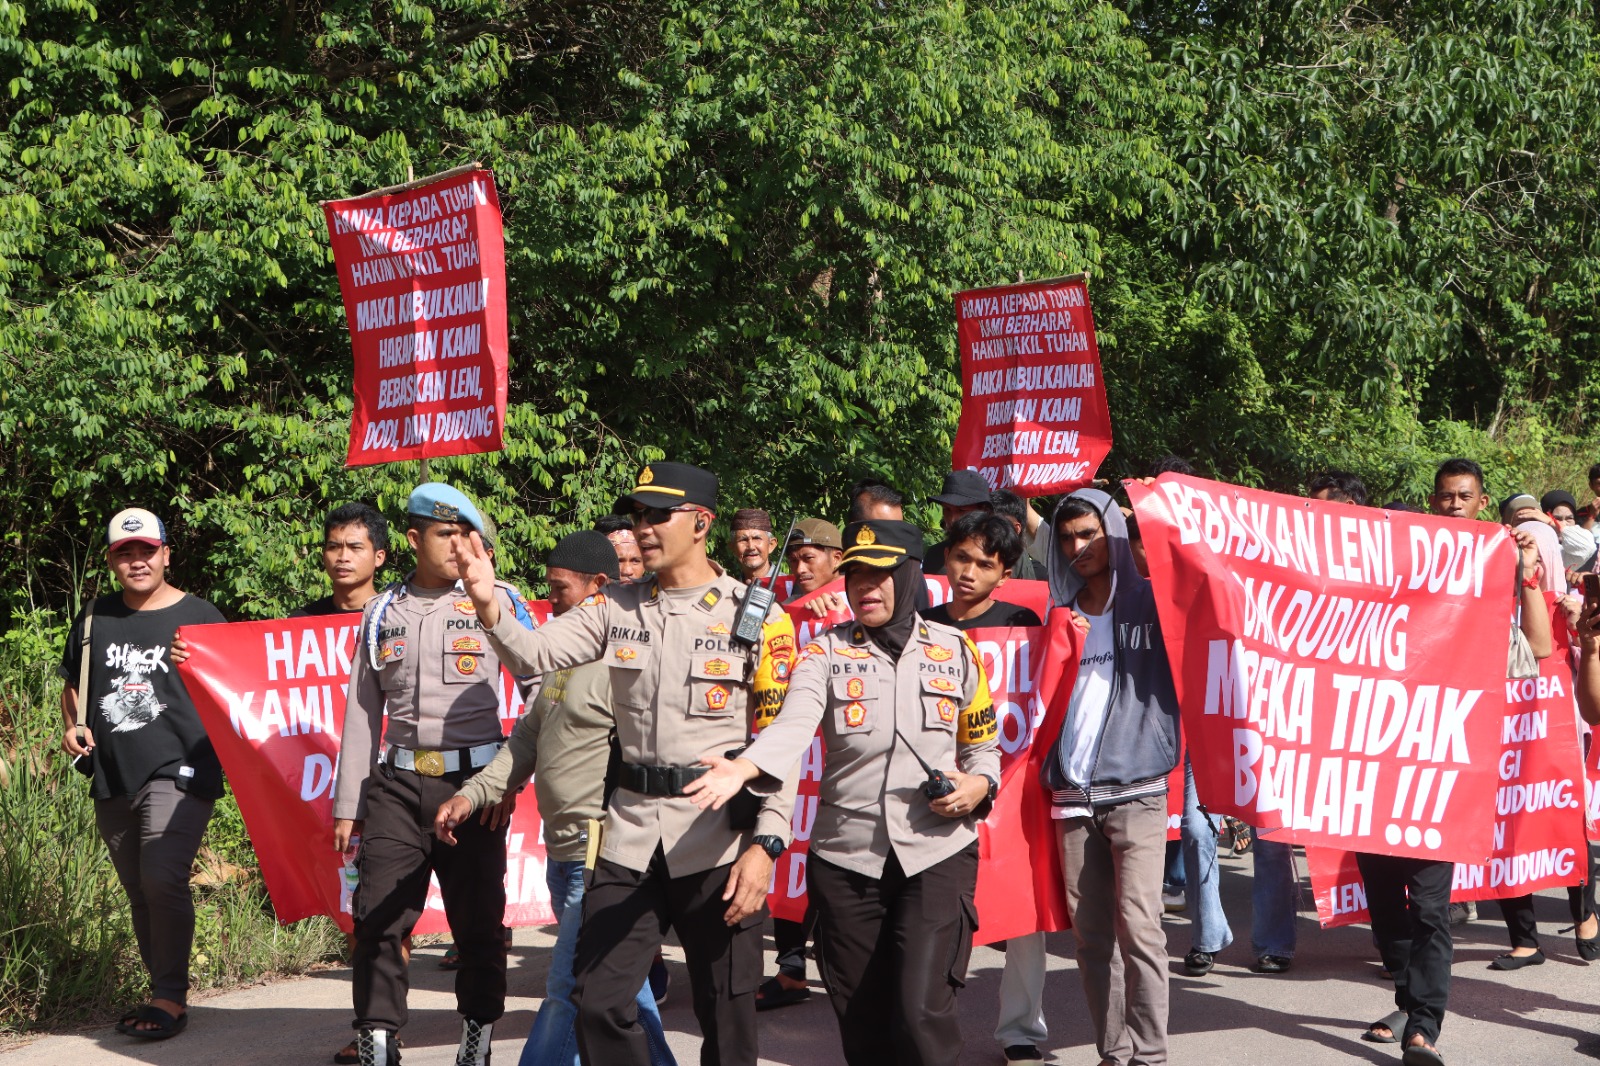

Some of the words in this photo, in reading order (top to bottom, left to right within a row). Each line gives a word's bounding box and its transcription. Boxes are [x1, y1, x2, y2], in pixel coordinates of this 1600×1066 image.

[333, 207, 383, 235] HANYA
[387, 193, 442, 228] KEPADA
[440, 180, 487, 214] TUHAN
[391, 214, 472, 253] BERHARAP,
[351, 257, 396, 287] HAKIM
[357, 296, 396, 332] MAKA
[961, 297, 999, 319] HANYA
[1001, 290, 1048, 315] KEPADA
[1046, 287, 1086, 309] TUHAN
[1005, 310, 1075, 335] BERHARAP,
[379, 330, 438, 369] HARAPAN
[441, 323, 480, 360] KAMI
[971, 338, 1005, 361] HAKIM
[1004, 335, 1044, 357] WAKIL
[1044, 332, 1089, 353] TUHAN
[377, 370, 447, 410] BEBASKAN
[449, 366, 483, 401] LENI,
[971, 369, 1003, 397] MAKA
[1004, 363, 1095, 392] KABULKANLAH
[1038, 397, 1082, 423] KAMI
[362, 419, 400, 452] DODI,
[402, 412, 432, 447] DAN
[433, 404, 495, 443] DUDUNG
[1043, 430, 1080, 458] LENI,
[1022, 461, 1090, 486] DUDUNG
[1160, 481, 1320, 576] BEBASKAN
[1323, 513, 1402, 598] LENI,
[1408, 525, 1484, 597] DODI
[446, 618, 483, 631] POLR
[1279, 589, 1410, 670] DUDUNG
[264, 626, 359, 681] HAK
[694, 638, 742, 654] POLRI
[832, 662, 877, 675] DEWI
[919, 662, 961, 677] POLRI
[1505, 676, 1565, 703] KOBA
[229, 685, 334, 741] KAMI
[1330, 673, 1484, 764] TIDAK
[1501, 710, 1547, 745] KAN
[1499, 749, 1522, 781] GI
[1384, 765, 1458, 849] !!!
[1496, 779, 1579, 816] UDUNG.
[1331, 881, 1368, 916] LEN
[1451, 863, 1484, 891] AN
[1490, 847, 1575, 888] DUDUNG
